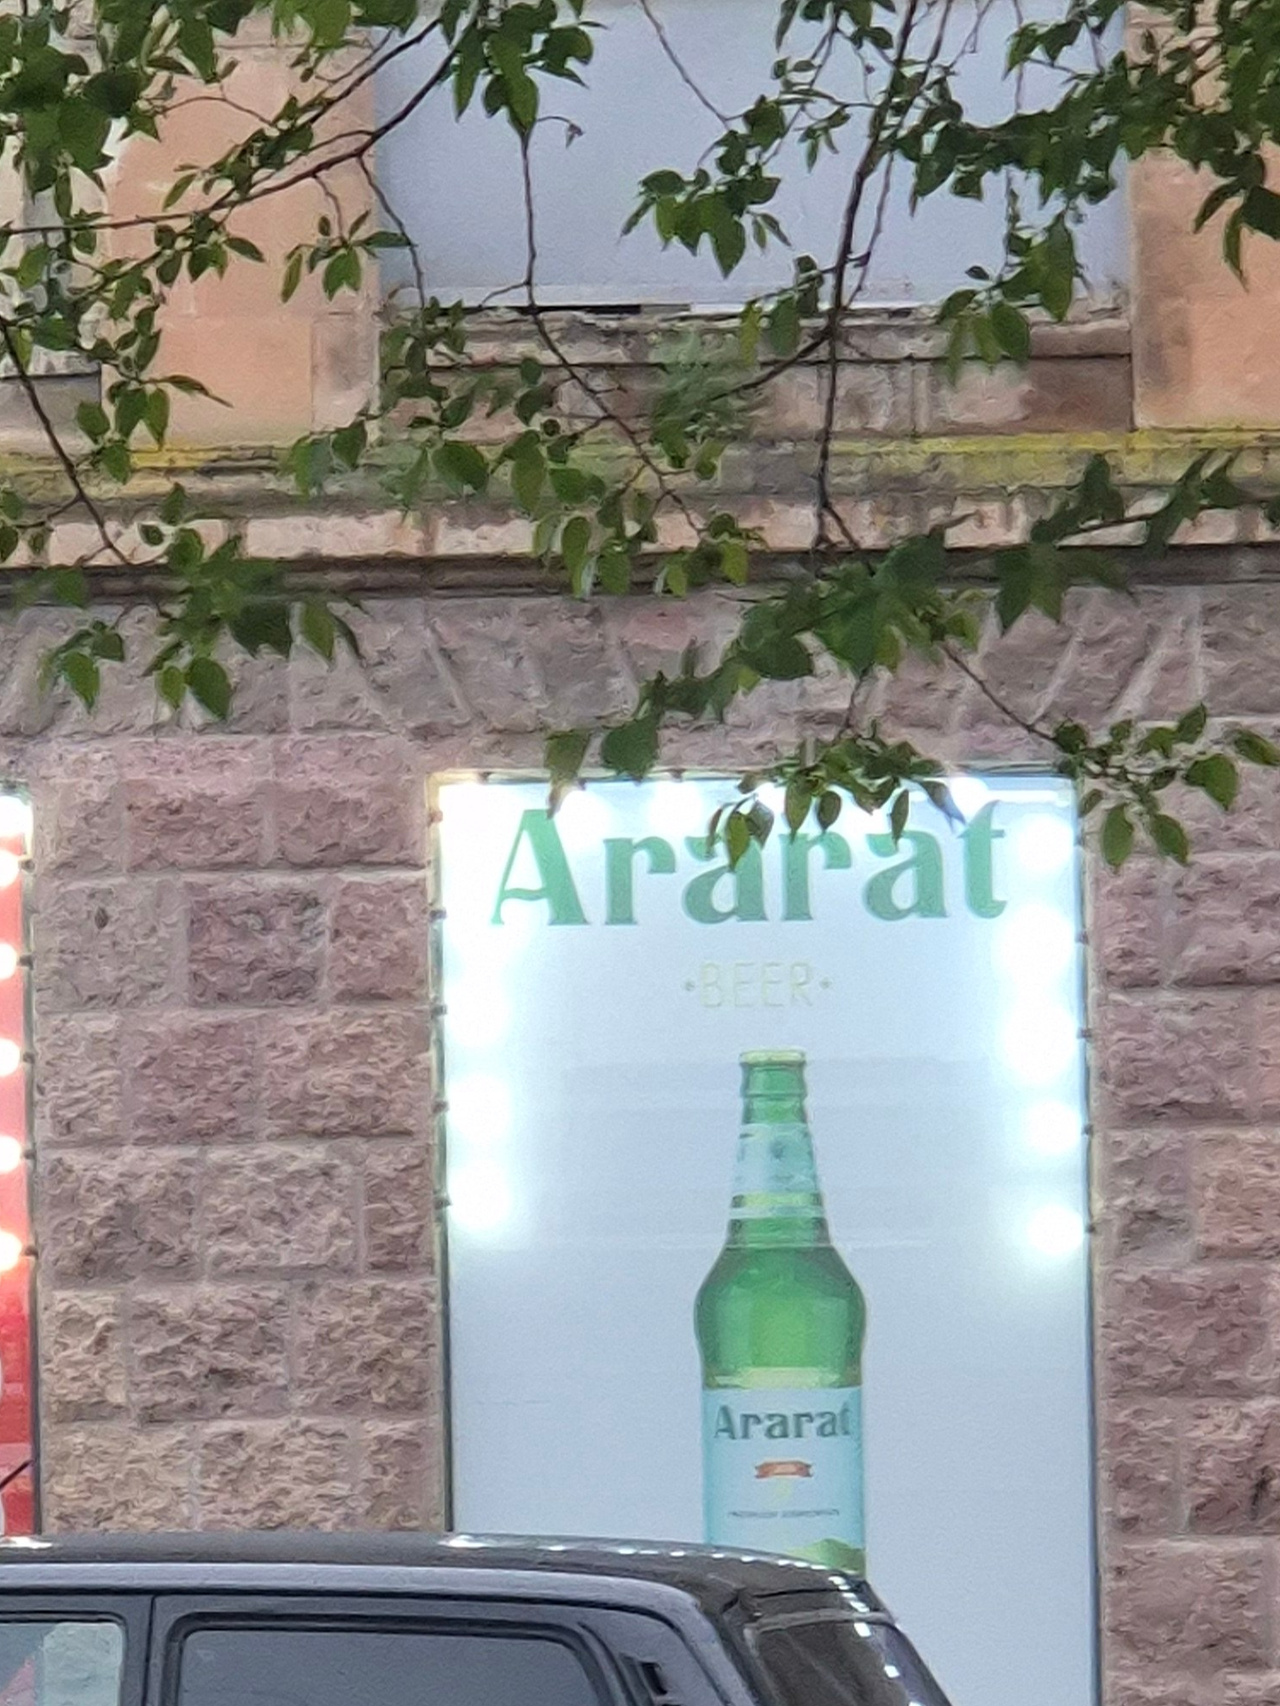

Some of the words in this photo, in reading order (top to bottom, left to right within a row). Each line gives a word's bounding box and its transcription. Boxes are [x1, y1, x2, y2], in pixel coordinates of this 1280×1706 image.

[489, 799, 1009, 926] Ararat
[698, 961, 815, 1009] BEER
[713, 1401, 852, 1441] Ararat
